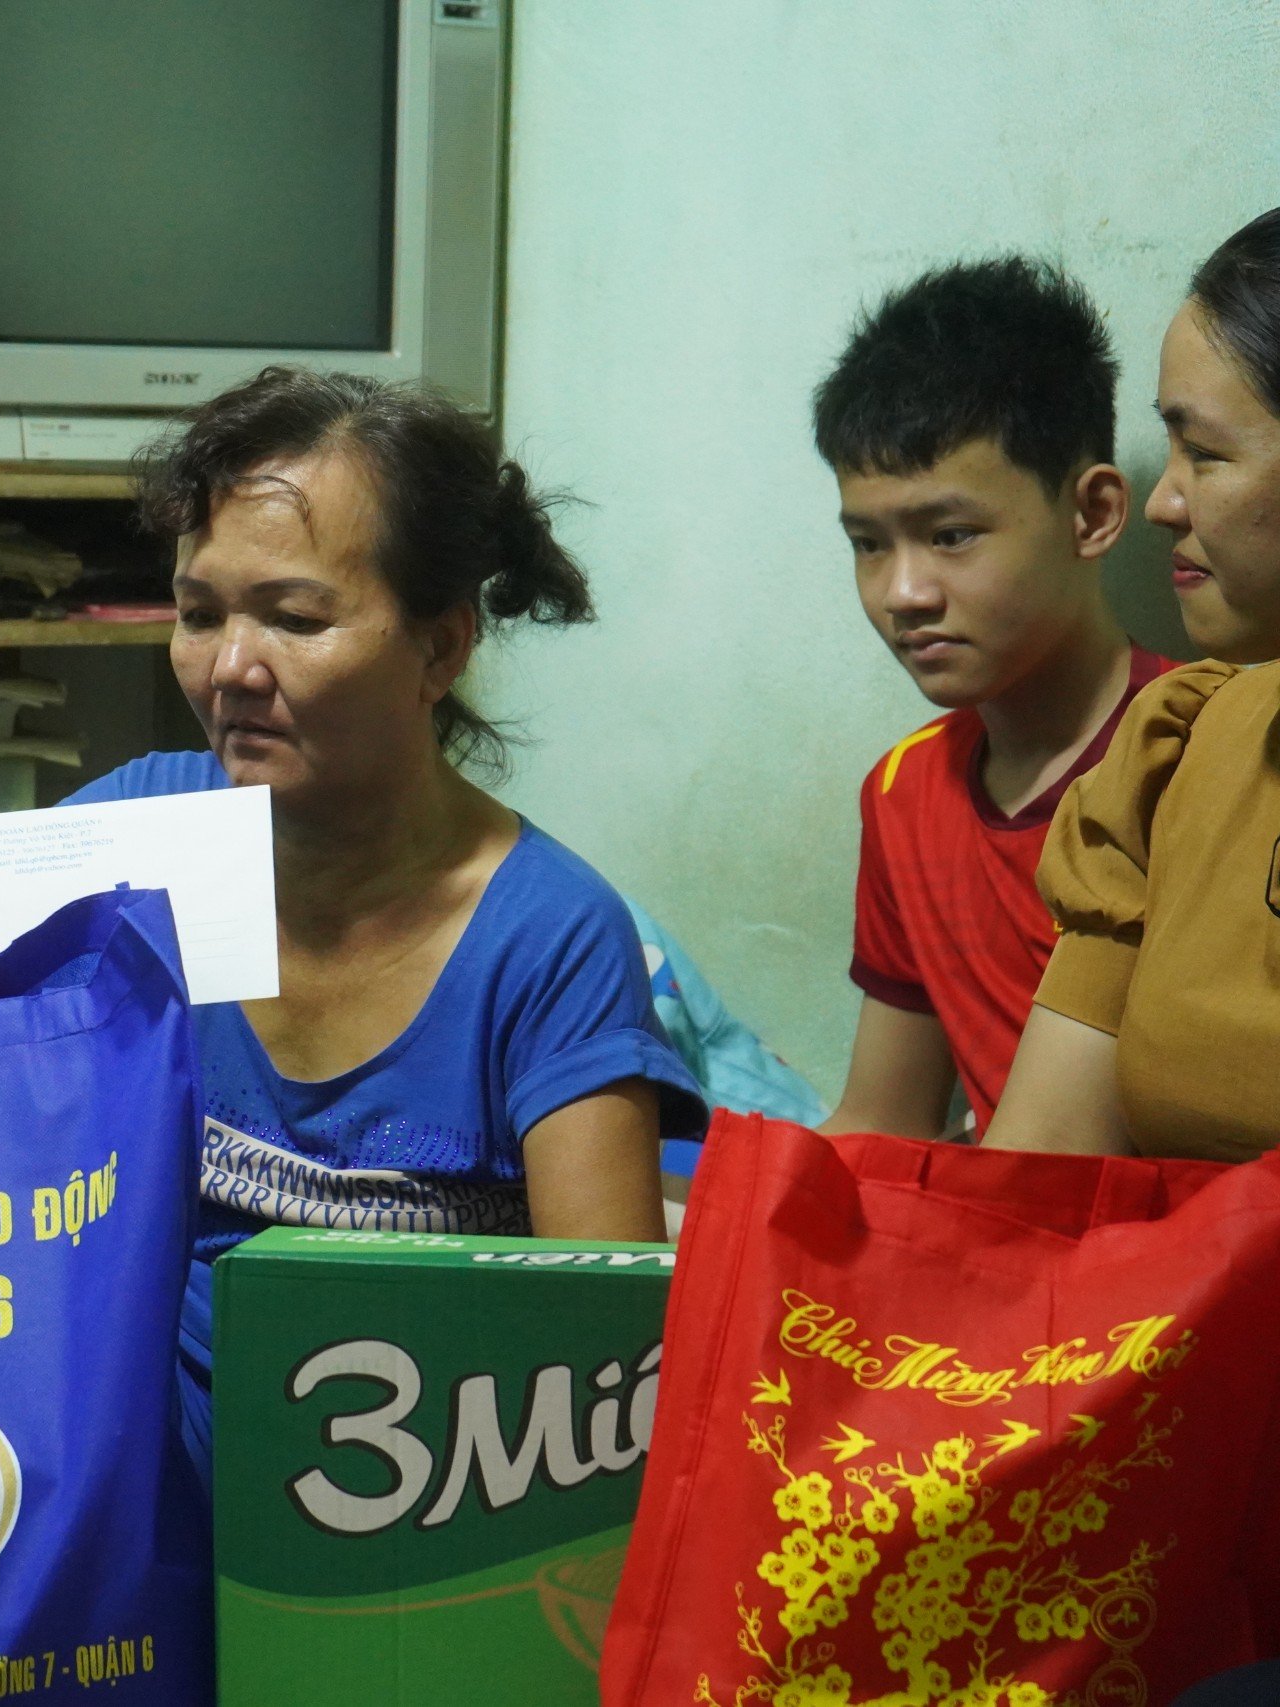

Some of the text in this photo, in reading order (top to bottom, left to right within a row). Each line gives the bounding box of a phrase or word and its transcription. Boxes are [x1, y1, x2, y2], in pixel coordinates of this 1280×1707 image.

[32, 1151, 118, 1247] ĐỘNG
[779, 1288, 883, 1377] Chúc
[853, 1335, 1017, 1407] Mừng
[286, 1338, 434, 1536] 3
[43, 1651, 55, 1688] 7
[76, 1635, 136, 1688] QUẬN
[142, 1634, 154, 1672] 6
